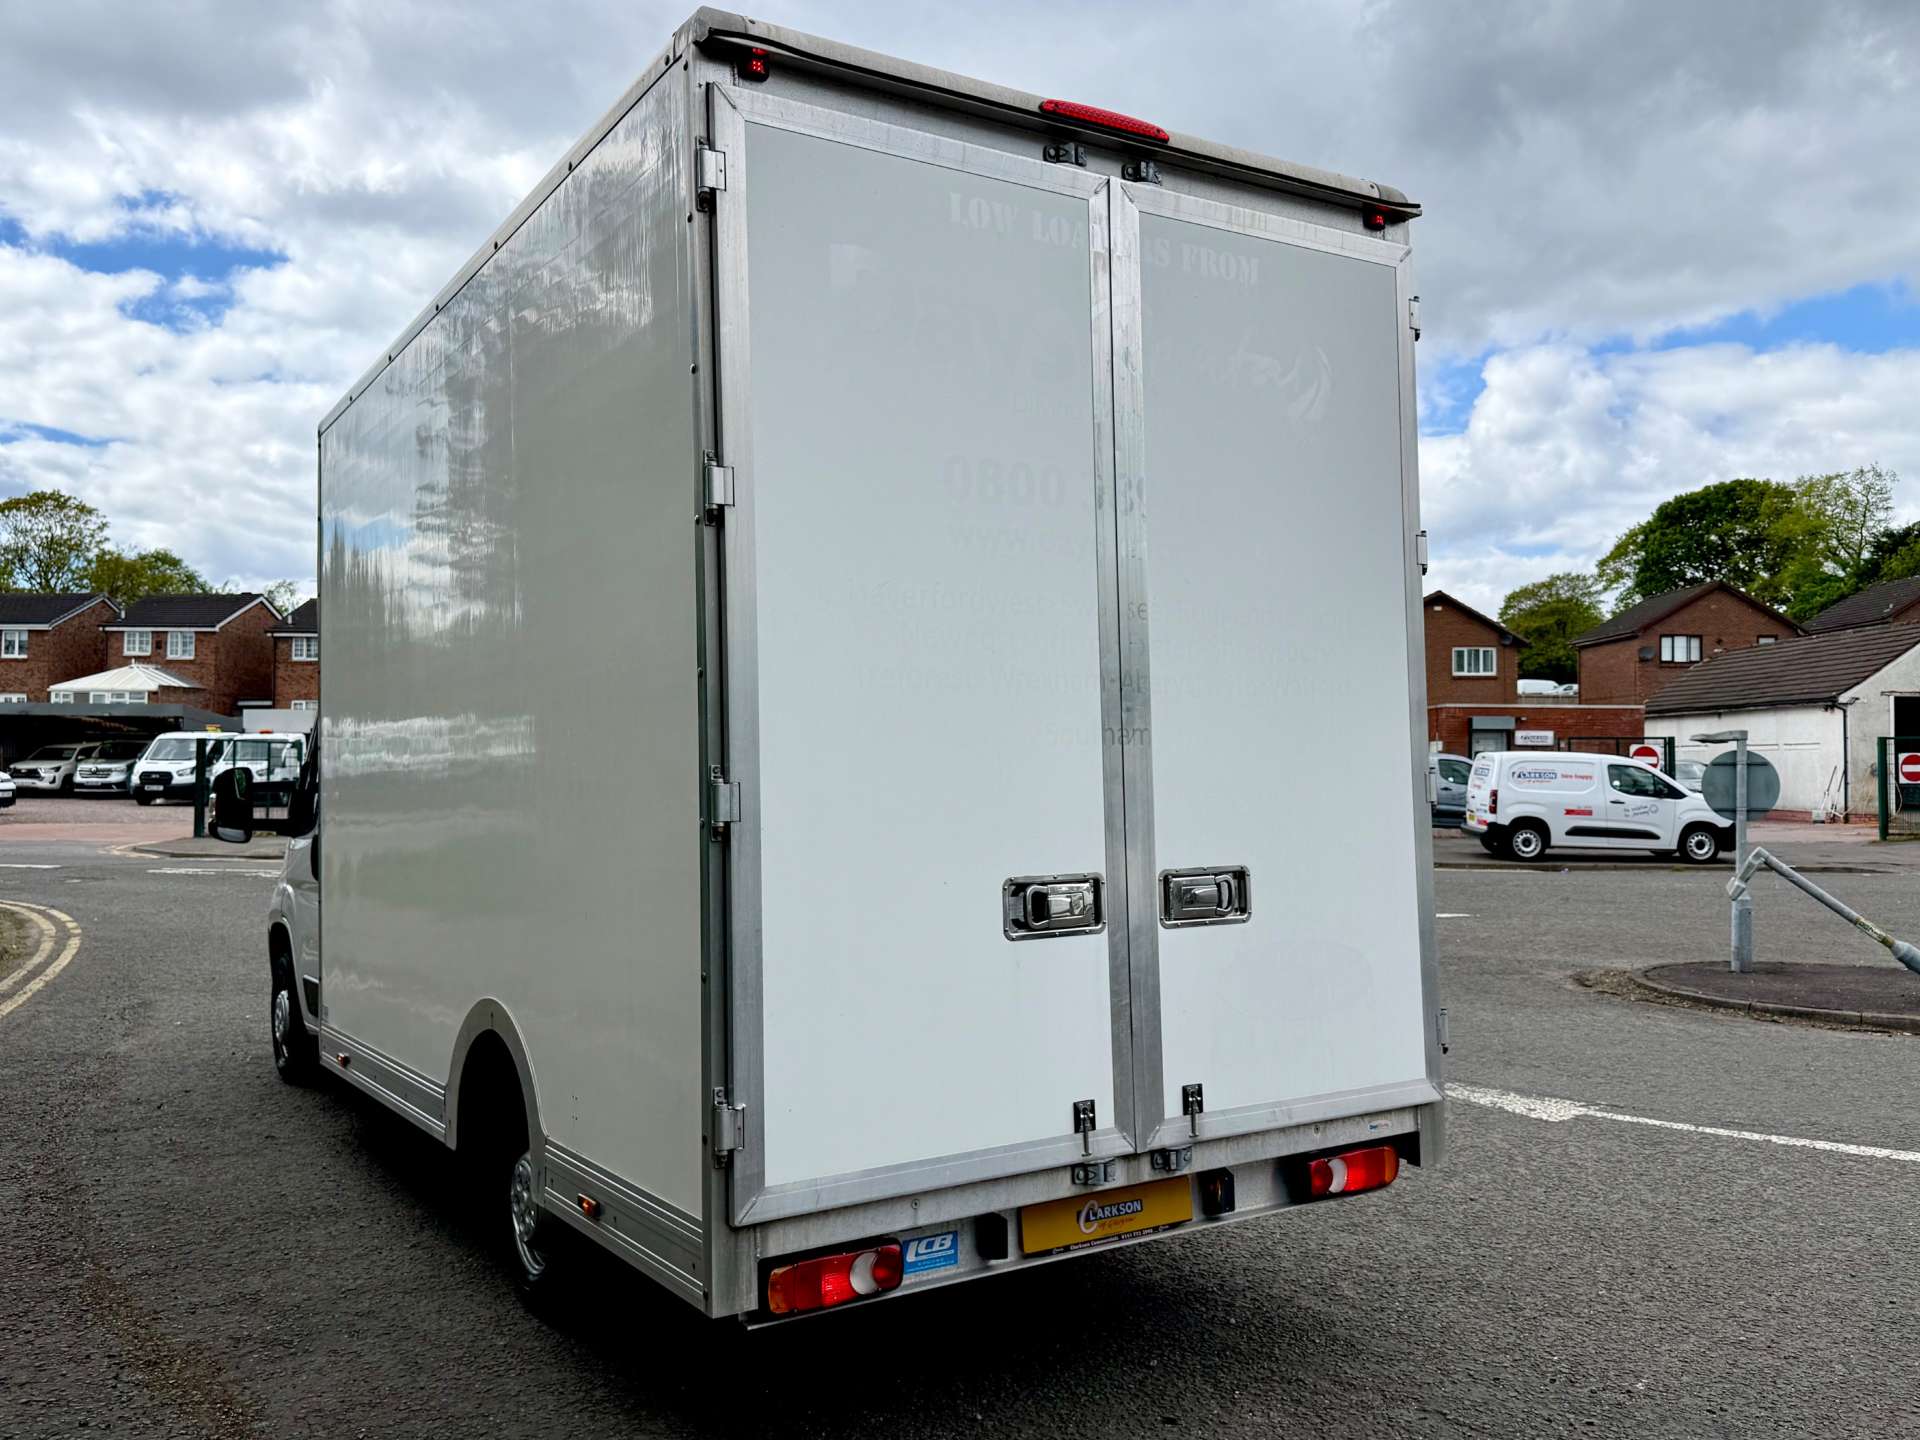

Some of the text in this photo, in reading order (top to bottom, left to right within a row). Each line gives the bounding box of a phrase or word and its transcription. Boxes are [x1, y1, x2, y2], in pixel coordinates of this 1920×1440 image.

[949, 192, 1017, 233] LOW
[1180, 242, 1261, 285] FROM
[1079, 1199, 1142, 1234] CLARKSON
